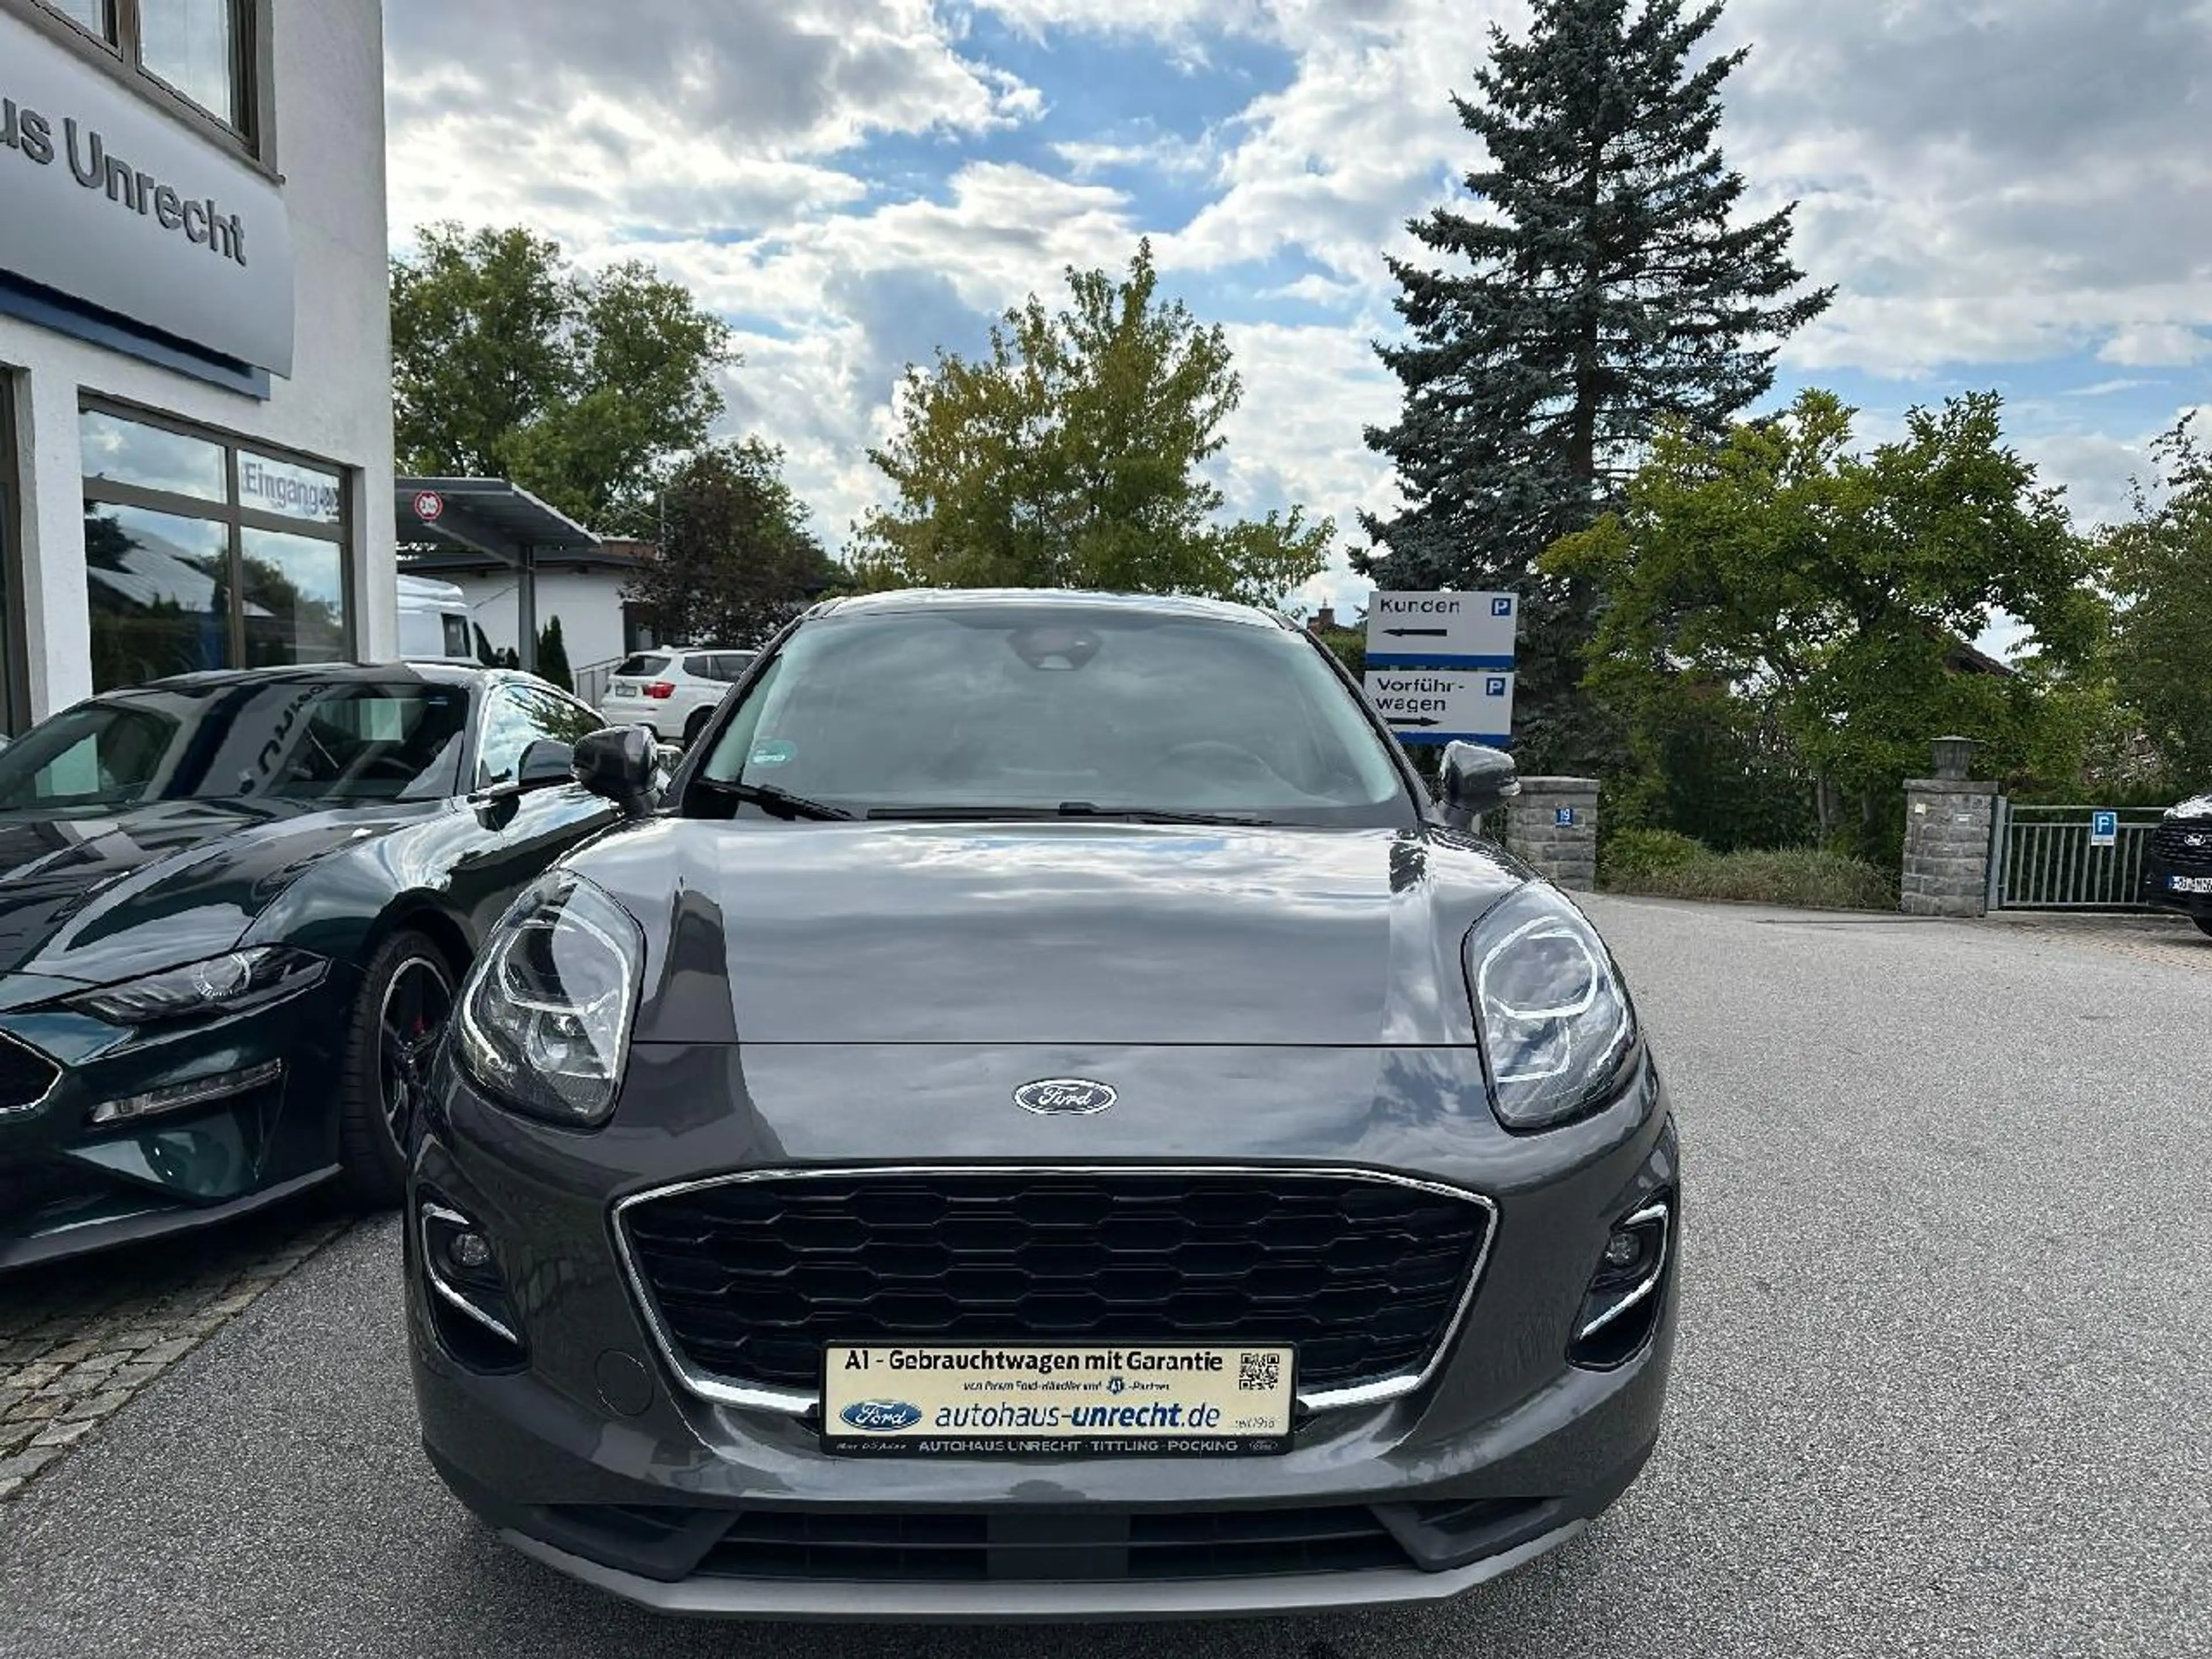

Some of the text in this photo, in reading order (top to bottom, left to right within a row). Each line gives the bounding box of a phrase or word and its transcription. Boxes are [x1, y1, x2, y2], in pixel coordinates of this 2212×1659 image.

[64, 118, 247, 267] Unrecht
[244, 463, 318, 516] Eingang
[1380, 599, 1460, 613] Kunden
[1494, 600, 1508, 615] P
[1377, 677, 1464, 692] Vorführ-
[1489, 680, 1503, 694] P
[1376, 698, 1446, 713] wagen
[1560, 808, 1570, 820] 19
[2097, 816, 2109, 832] P
[1038, 1085, 1093, 1106] Ford
[890, 1350, 1080, 1374] Gebrauchtwagen
[1085, 1351, 1122, 1370] mit
[1127, 1351, 1224, 1371] Garantie
[855, 1403, 907, 1425] Ford
[935, 1401, 1221, 1428] autohaus-unrecht.de
[920, 1441, 1003, 1451] AUTOHAUS
[1008, 1441, 1081, 1451] UNRECHT
[1090, 1441, 1158, 1451] TITTLING
[1167, 1441, 1238, 1451] POCKING
